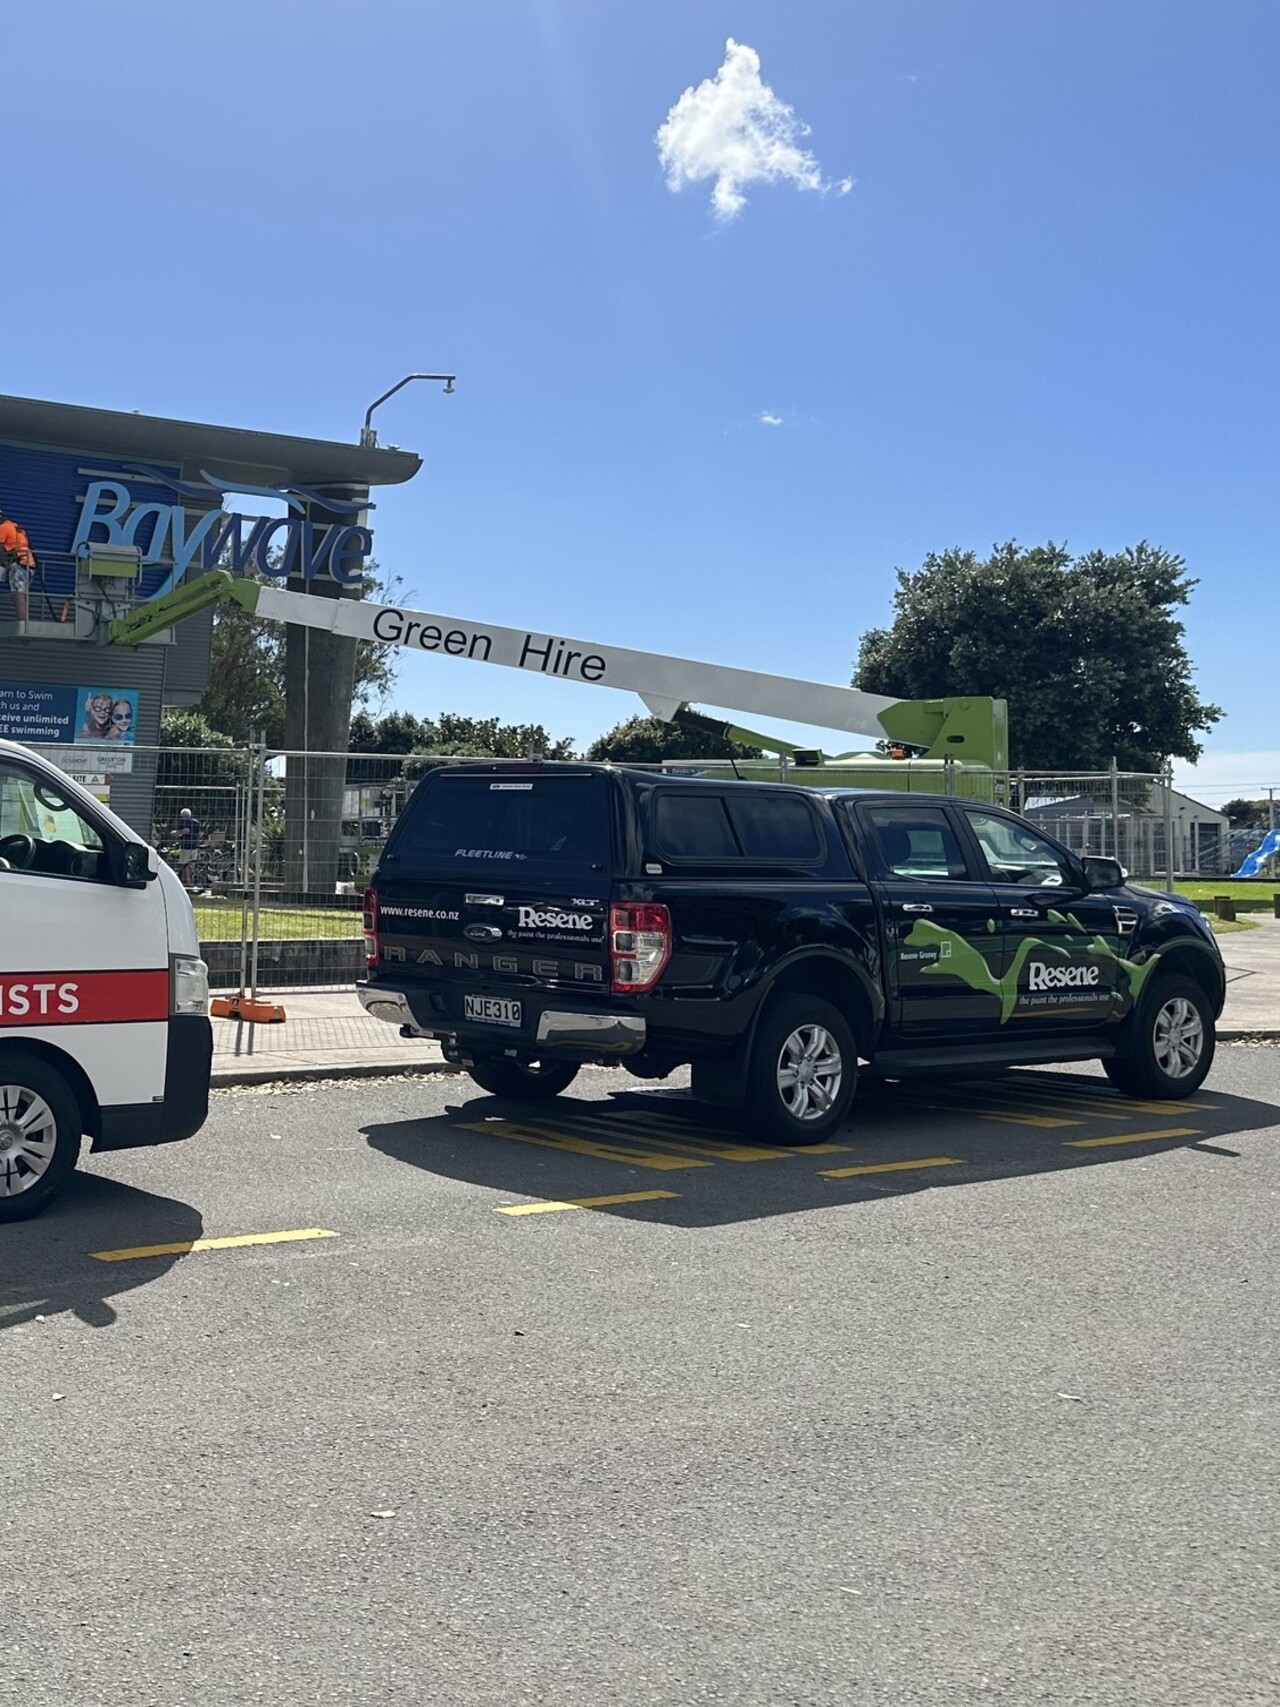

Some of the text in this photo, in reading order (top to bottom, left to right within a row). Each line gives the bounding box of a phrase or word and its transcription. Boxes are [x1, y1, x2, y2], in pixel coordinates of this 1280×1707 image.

[71, 480, 373, 603] Baywave
[372, 608, 607, 681] Green Hire
[16, 690, 26, 699] to
[28, 690, 53, 700] Swim
[9, 701, 20, 711] us
[22, 702, 40, 712] and
[23, 715, 69, 725] unlimited
[11, 726, 60, 738] swimming
[454, 848, 514, 860] FLEETLINE
[380, 906, 460, 921] www.resene.co.nz
[518, 906, 593, 930] Resene
[546, 932, 590, 942] professionals
[383, 945, 603, 981] RANGER
[1029, 961, 1099, 991] Resene
[465, 998, 520, 1020] NJE310
